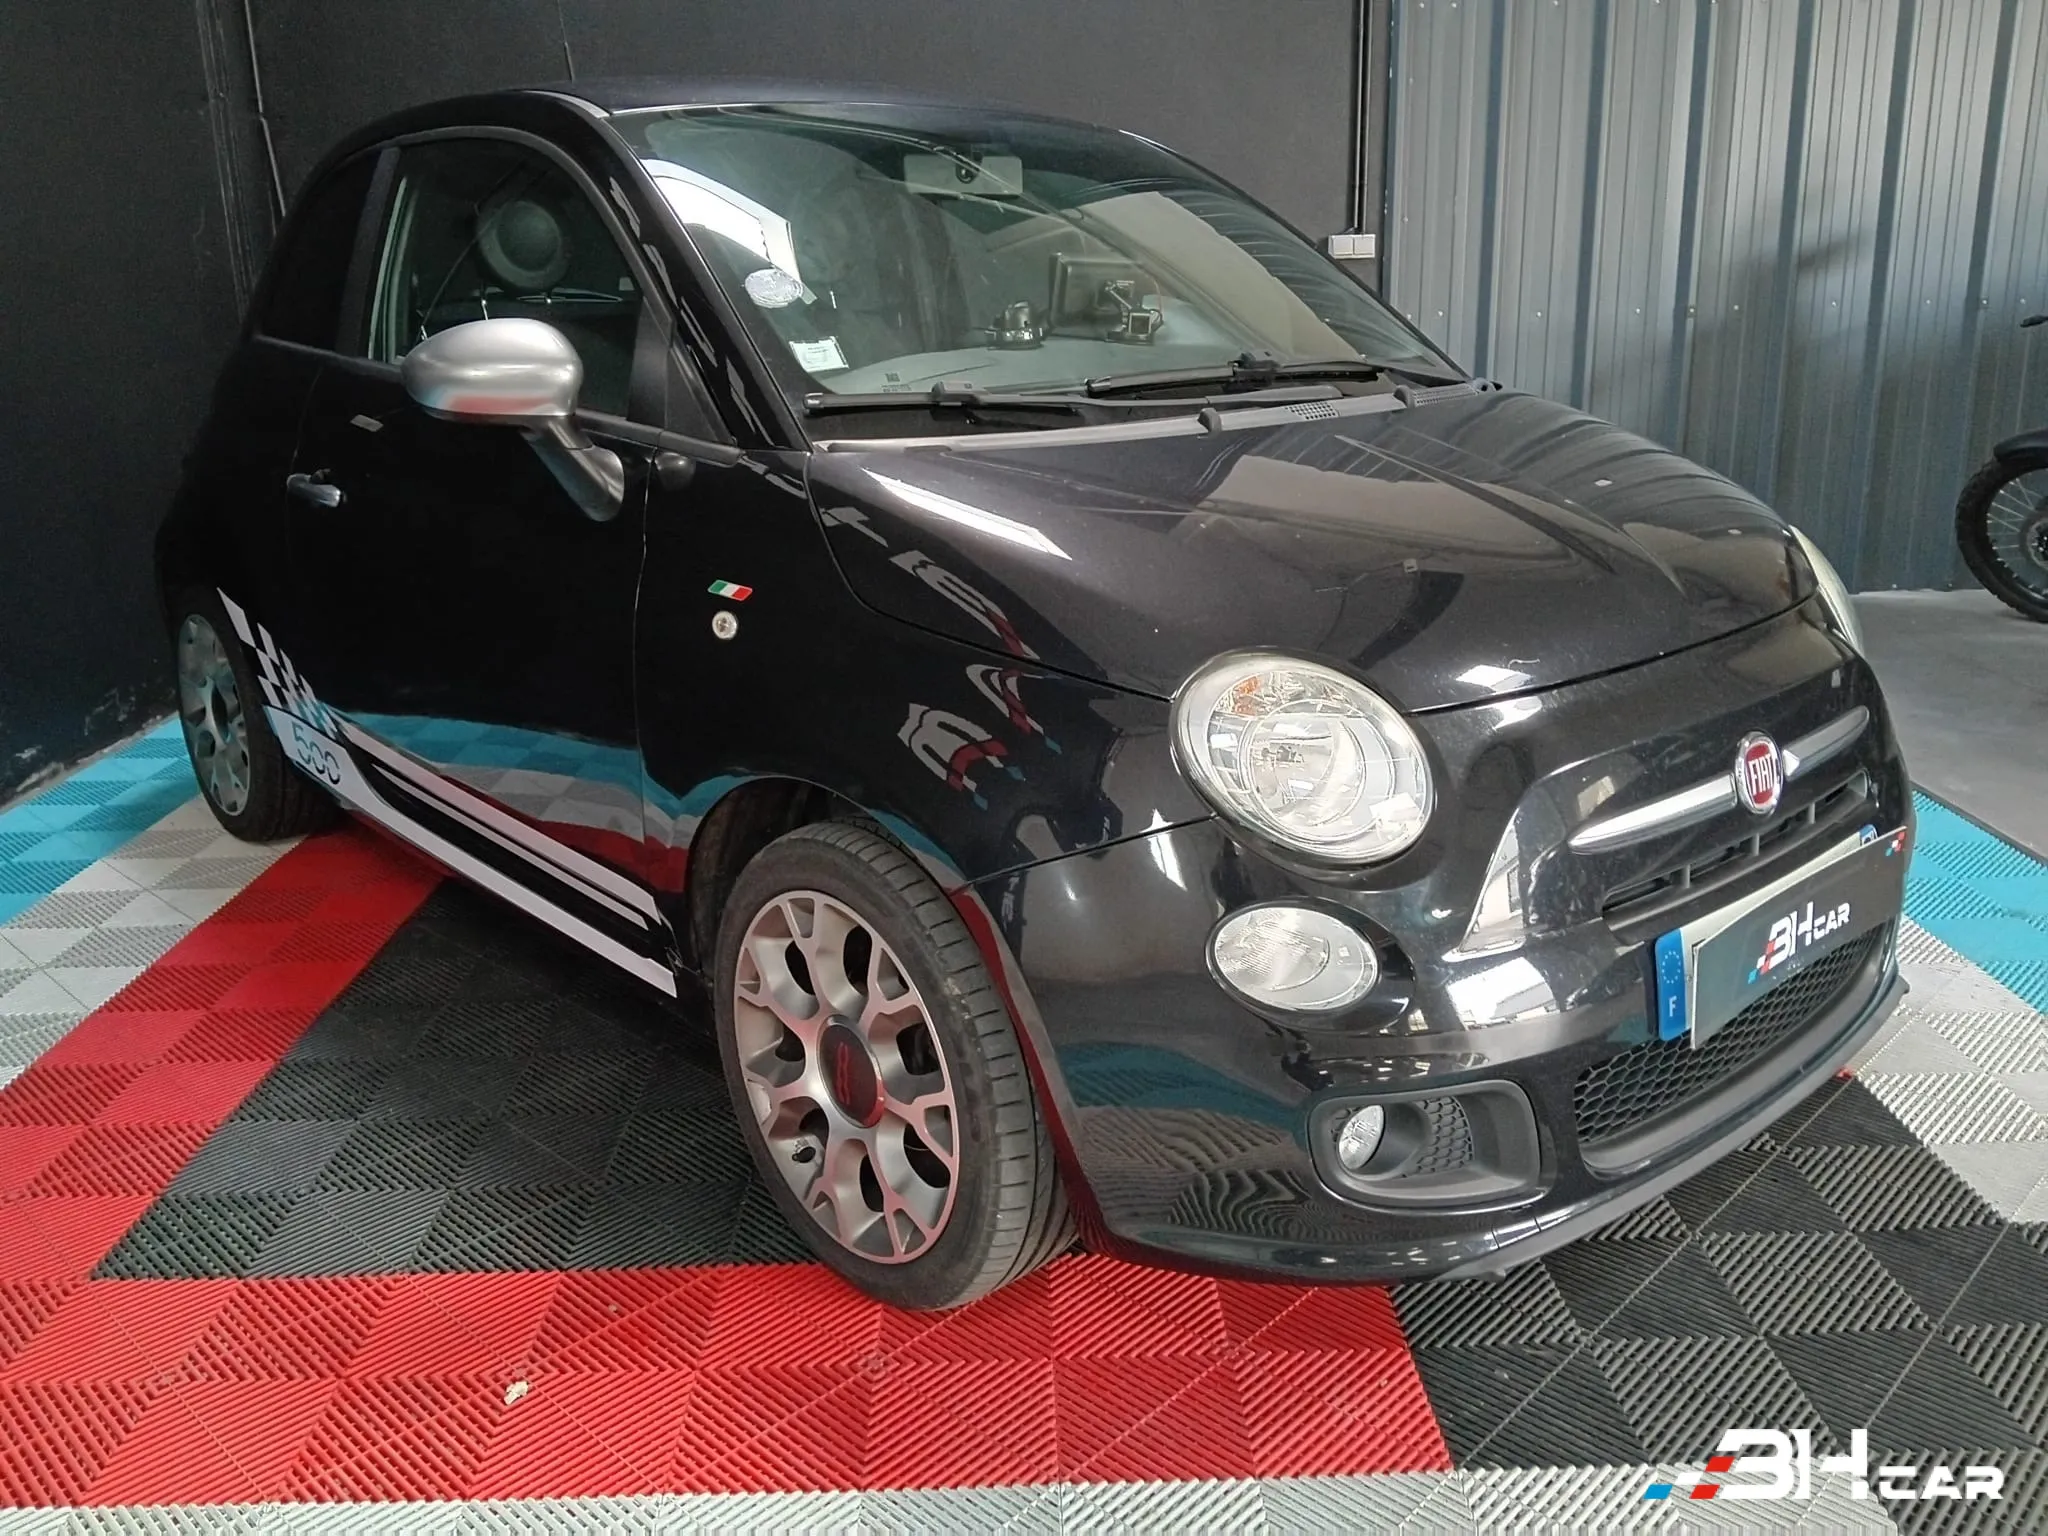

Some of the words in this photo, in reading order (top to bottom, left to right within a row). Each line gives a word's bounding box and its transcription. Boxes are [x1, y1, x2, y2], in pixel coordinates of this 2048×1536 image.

[291, 721, 341, 785] 500
[1748, 753, 1774, 796] FIAT
[1669, 995, 1678, 1017] F
